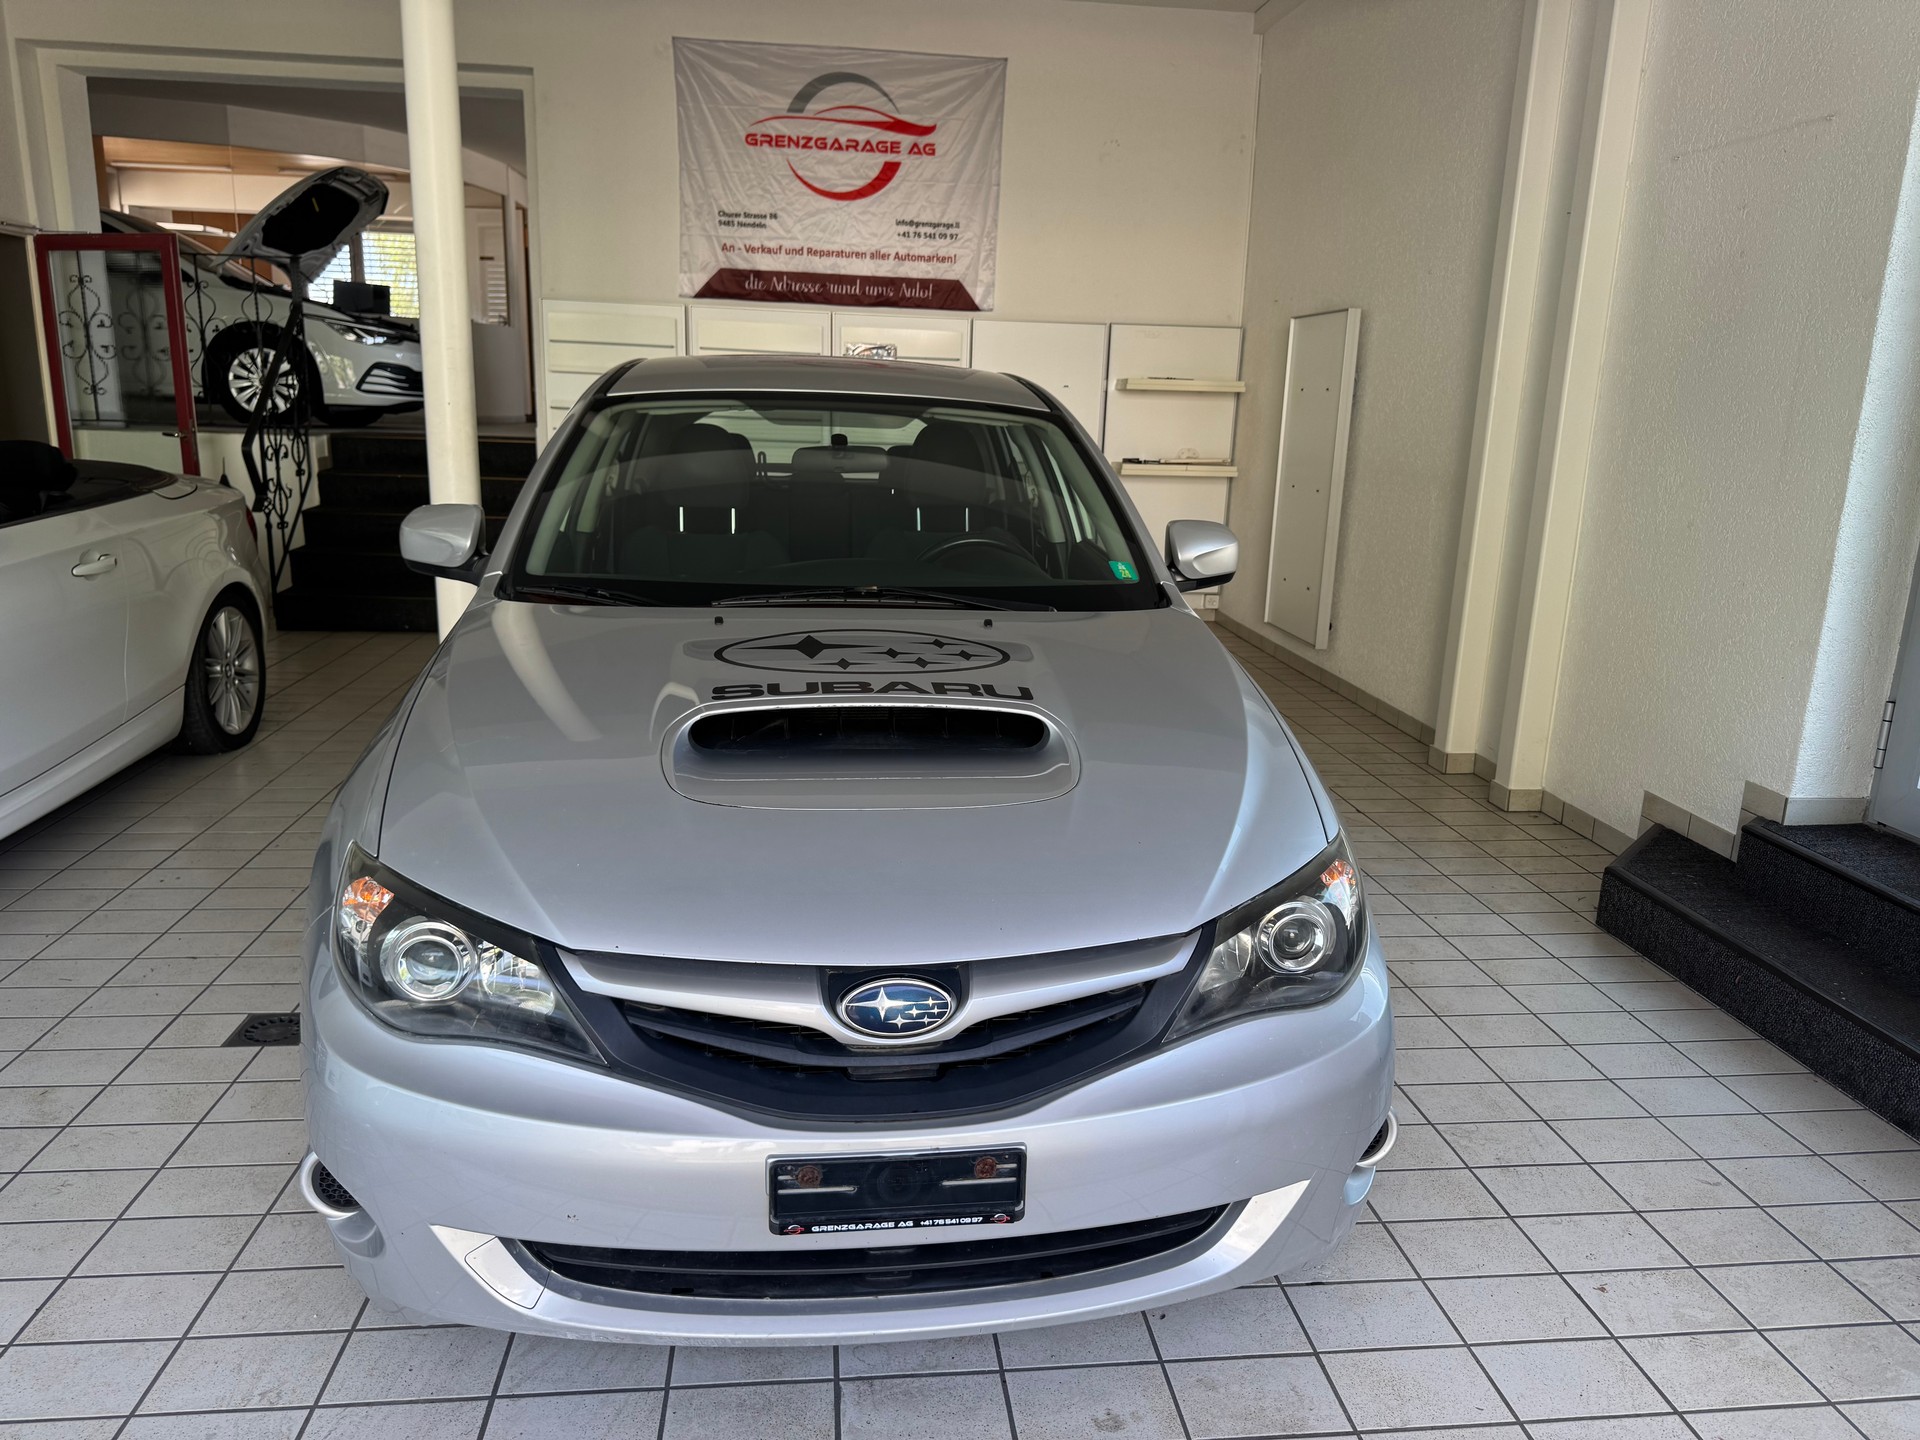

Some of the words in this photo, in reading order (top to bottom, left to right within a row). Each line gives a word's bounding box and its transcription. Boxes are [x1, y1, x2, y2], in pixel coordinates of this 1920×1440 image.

[745, 133, 902, 154] GRENZGARAGE
[907, 142, 936, 156] AG
[743, 211, 767, 219] Strasse
[938, 232, 948, 240] 09
[721, 243, 735, 252] An
[744, 244, 783, 255] Verkauf
[785, 246, 804, 256] und
[806, 247, 867, 260] Reparaturen
[869, 249, 891, 260] aller
[893, 251, 957, 264] Automarken!
[745, 273, 767, 291] die
[769, 275, 823, 294] Adresse
[826, 278, 864, 296] rund
[865, 284, 896, 297] ums
[899, 281, 933, 300] Auto!
[712, 681, 1034, 701] SUBARU
[811, 1221, 896, 1233] GRENZGARAGE
[898, 1220, 914, 1228] AG
